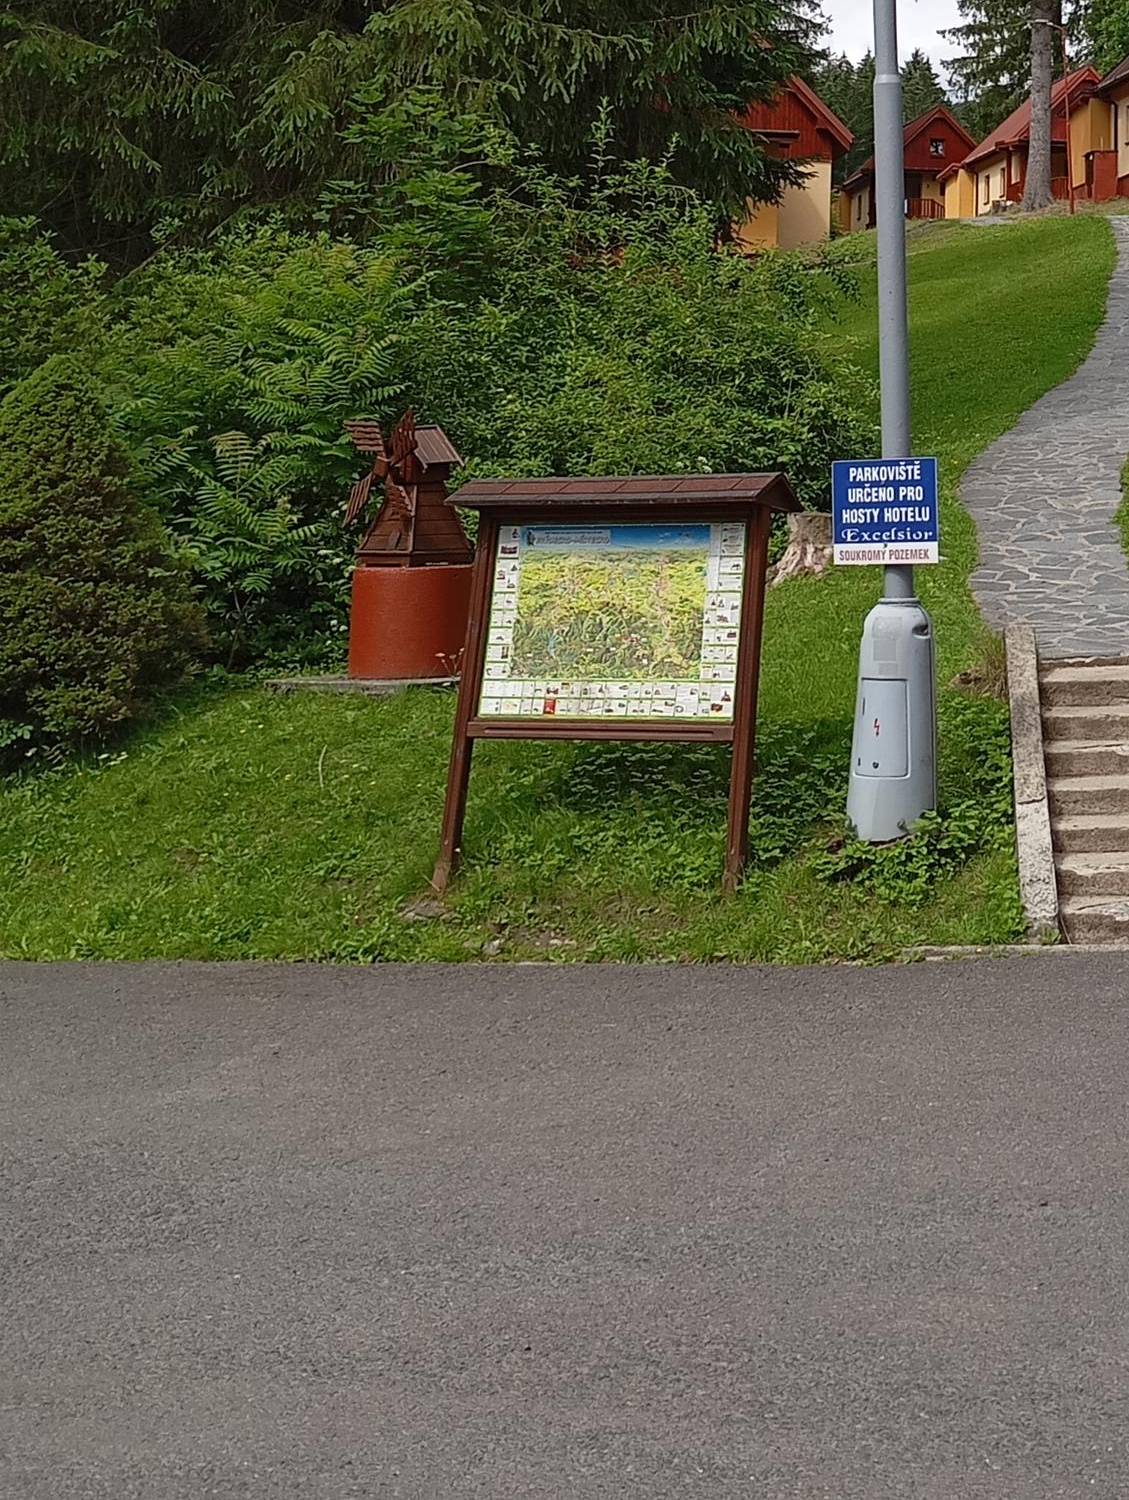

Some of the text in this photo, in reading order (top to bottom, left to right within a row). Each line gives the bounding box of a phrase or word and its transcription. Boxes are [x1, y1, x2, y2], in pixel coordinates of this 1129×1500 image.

[849, 461, 921, 482] PARKOVIŠTĚ
[848, 484, 923, 503] URČENO PRO
[842, 506, 930, 524] HOSTY HOTELU
[841, 527, 933, 542] Excelsior
[889, 549, 929, 560] POZEMEK
